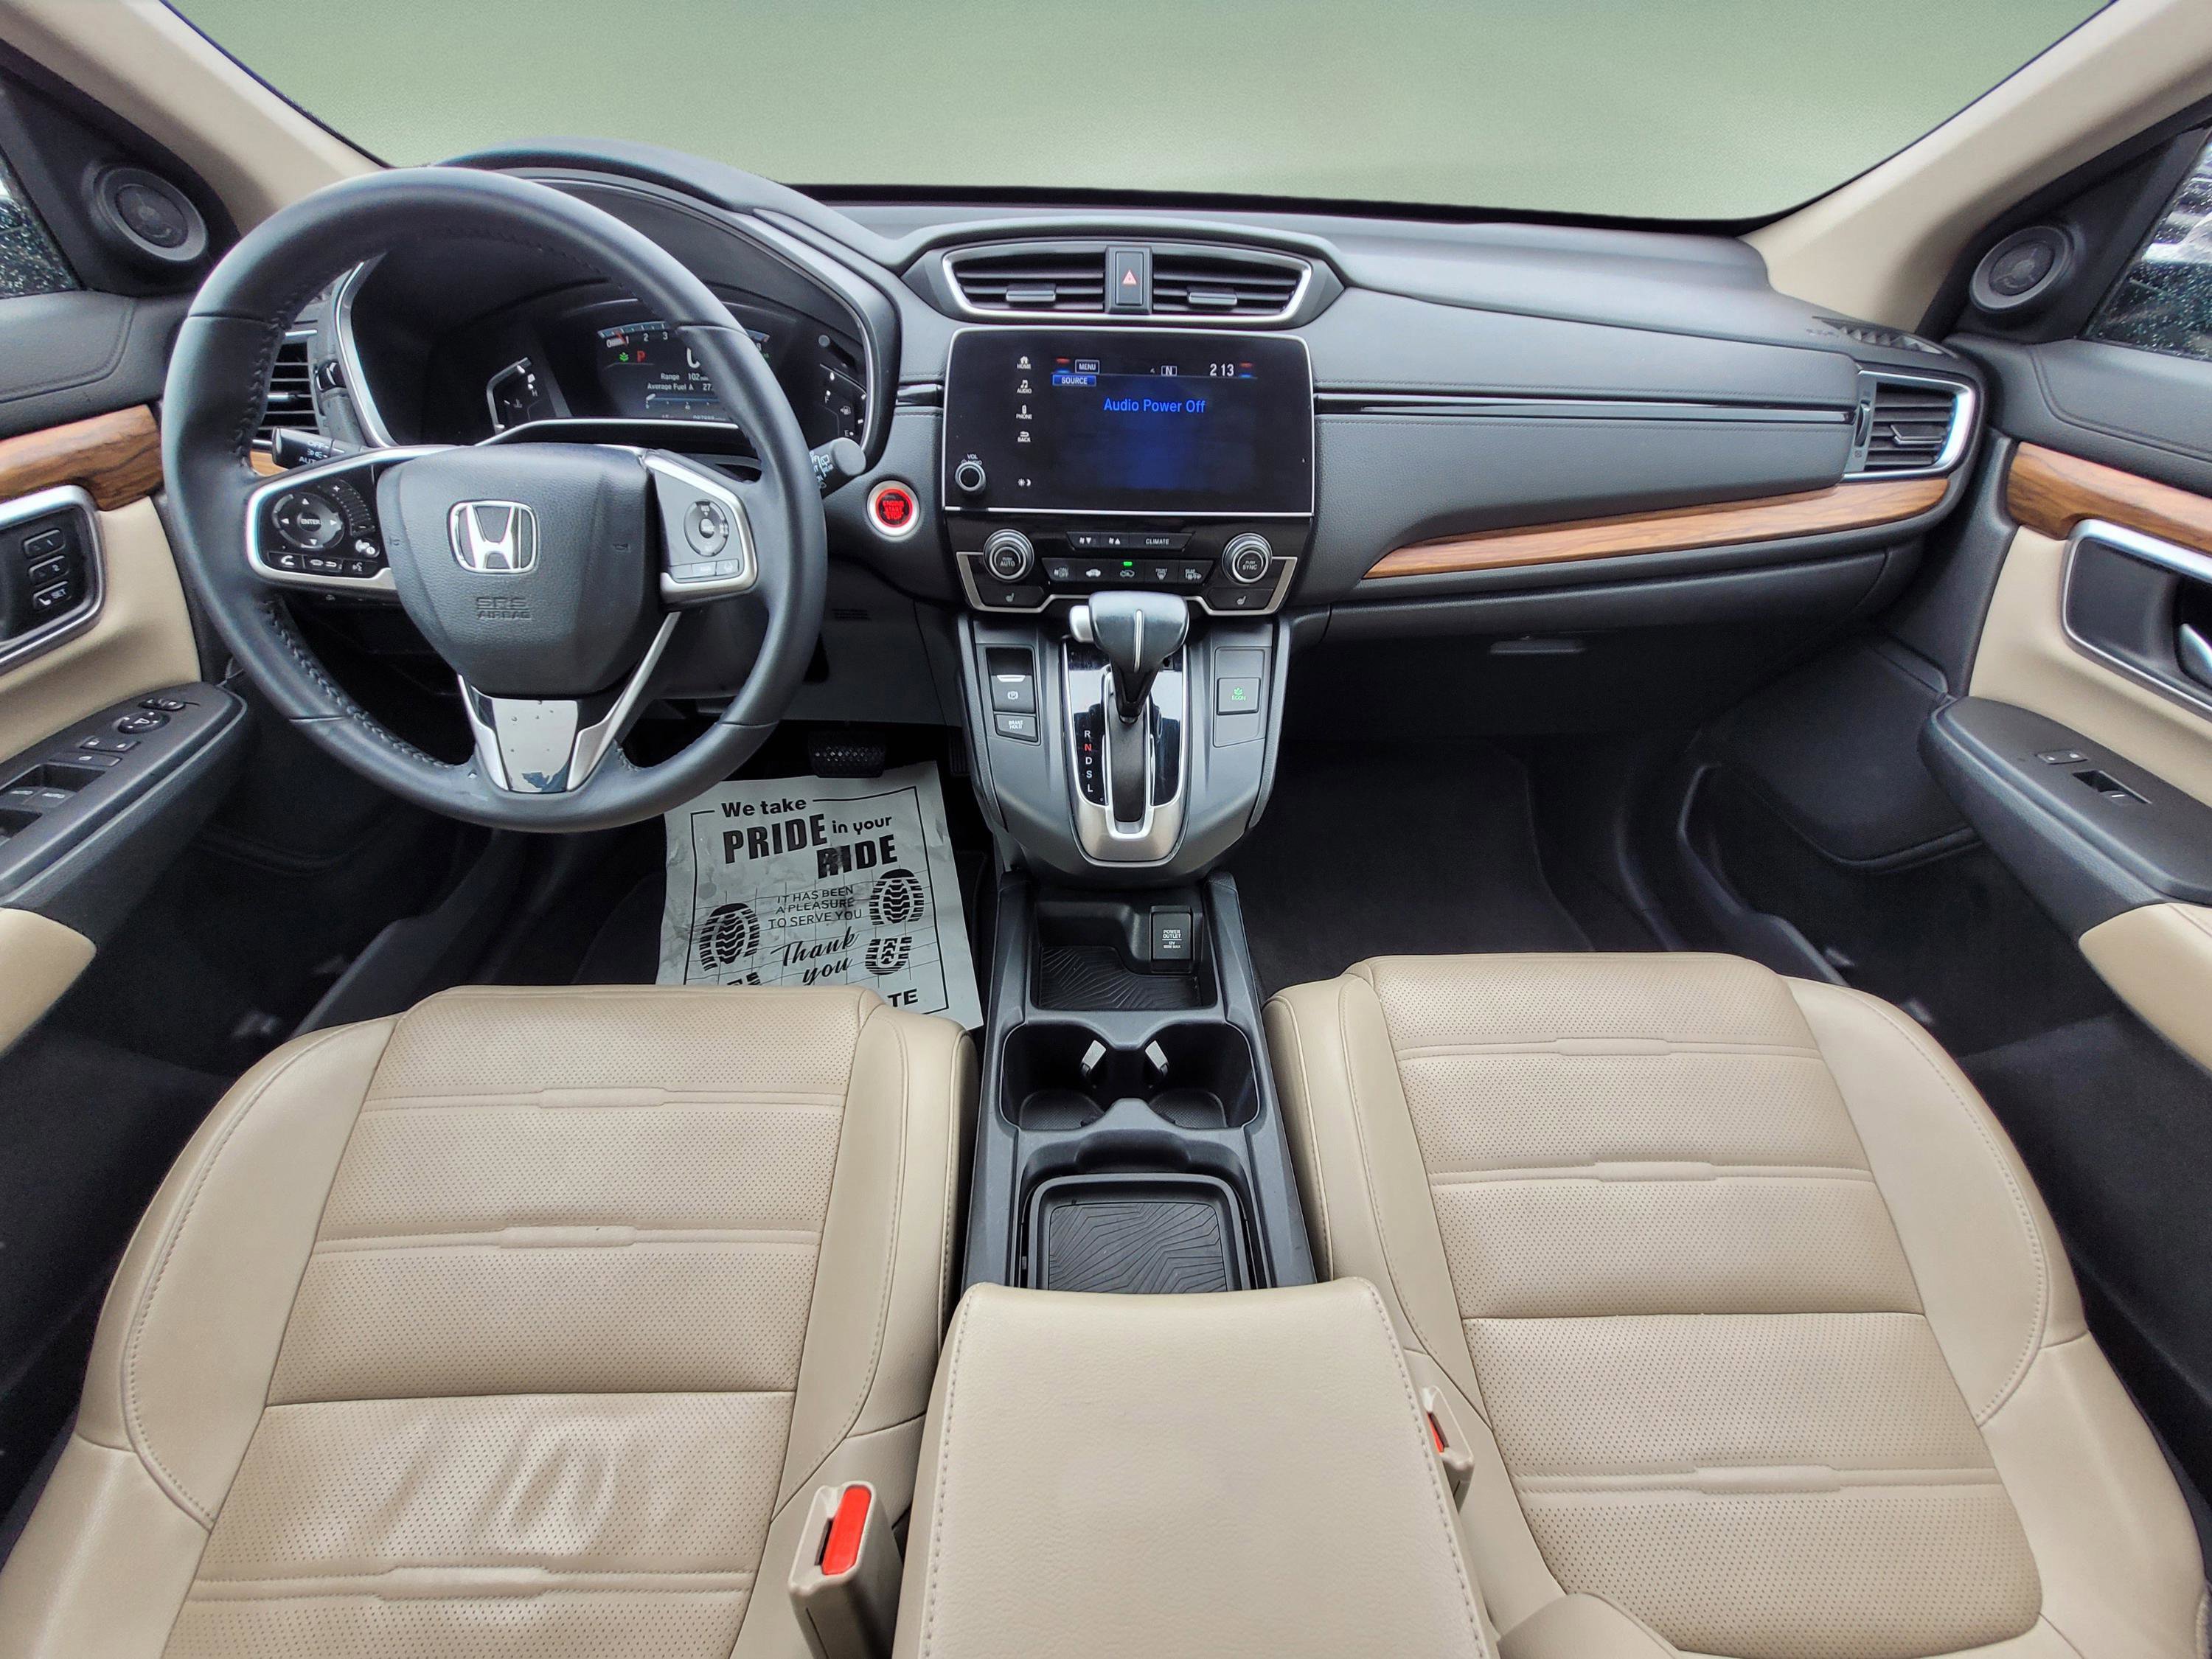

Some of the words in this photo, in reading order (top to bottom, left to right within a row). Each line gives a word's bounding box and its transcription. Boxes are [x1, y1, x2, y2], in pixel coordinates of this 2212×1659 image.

[644, 333, 649, 342] 2
[663, 332, 668, 340] 3
[637, 350, 646, 362] P
[1079, 363, 1096, 371] MENU
[1166, 366, 1172, 375] N
[661, 372, 680, 381] Range
[688, 372, 700, 380] 102
[1061, 376, 1088, 385] SOURCE
[647, 383, 672, 391] Average
[673, 383, 686, 391] Fuel
[1104, 397, 1139, 411] Audio
[1143, 399, 1182, 412] Power
[1186, 400, 1206, 413] Off
[307, 440, 324, 448] OFF
[299, 456, 317, 465] AUT
[1085, 743, 1091, 751] N
[1085, 757, 1092, 765] D
[1088, 784, 1093, 792] L
[720, 801, 755, 818] We
[760, 799, 807, 815] take
[832, 820, 848, 834] in
[853, 816, 892, 835] your
[723, 813, 828, 864] PRIDE
[816, 834, 898, 880] RIDE
[777, 894, 790, 903] IT
[793, 890, 818, 902] HAS
[822, 885, 853, 897] BEEN
[776, 905, 785, 914] A
[788, 897, 854, 913] PLEASURE
[768, 917, 787, 929] TO
[790, 912, 832, 928] SERVE
[835, 908, 862, 920] YOU
[770, 926, 860, 967] Thank
[802, 957, 853, 986] you
